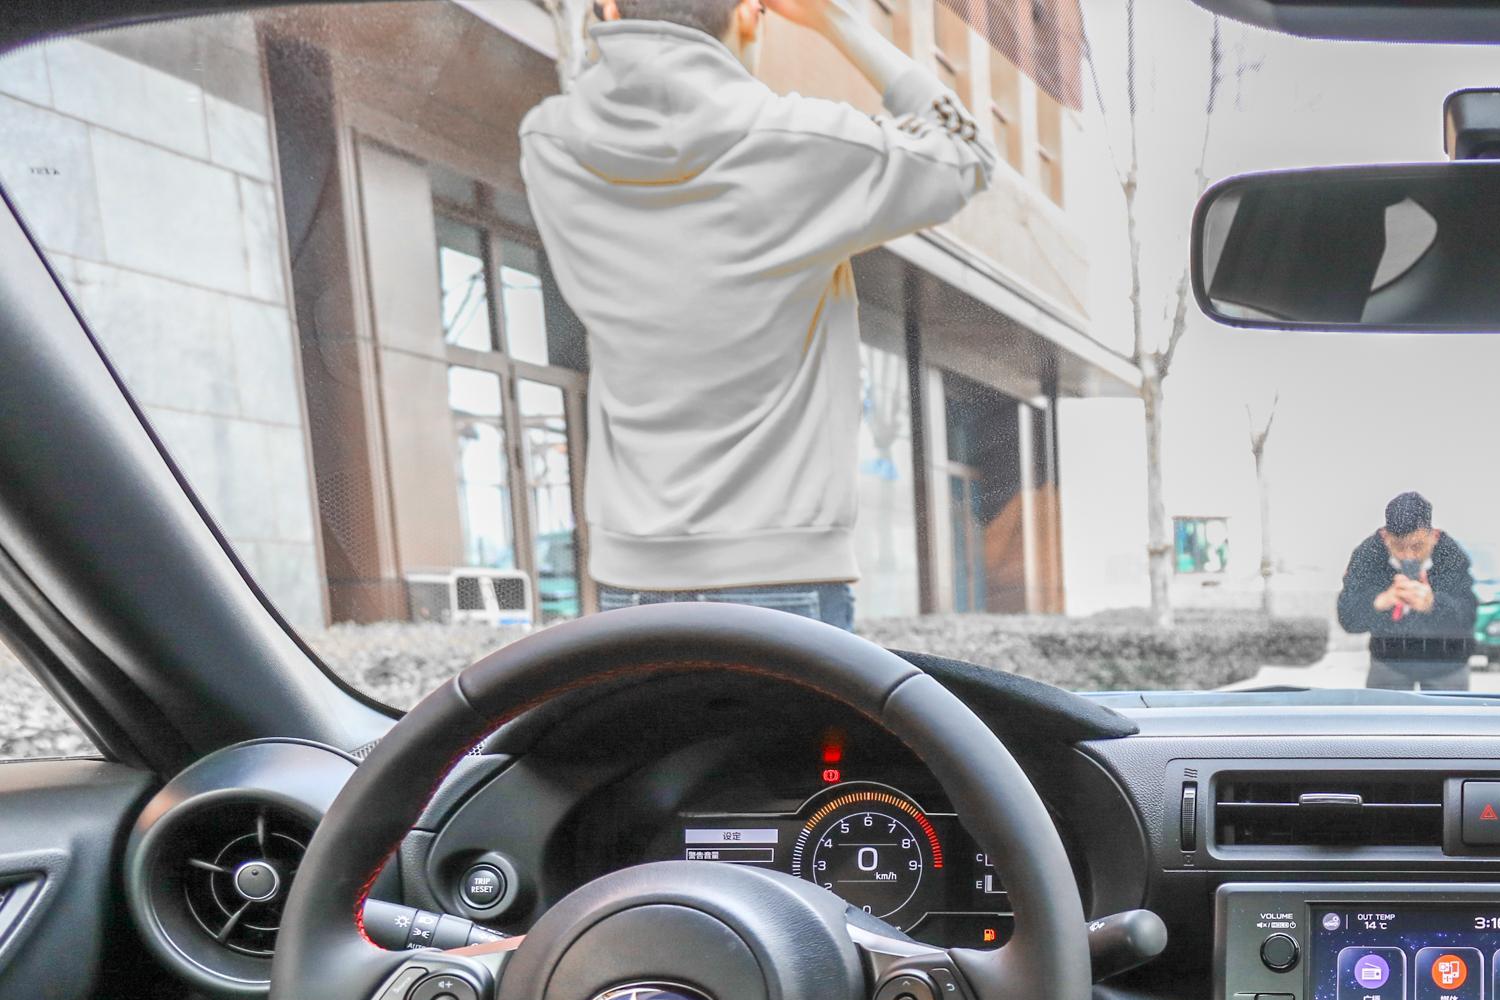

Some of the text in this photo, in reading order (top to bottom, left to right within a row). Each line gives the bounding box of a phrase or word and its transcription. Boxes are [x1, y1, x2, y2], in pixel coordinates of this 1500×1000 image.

[864, 817, 873, 826] 6
[841, 824, 849, 833] 5
[888, 824, 897, 833] 7
[723, 832, 741, 840] 设定
[824, 839, 833, 848] 4
[901, 838, 911, 849] 8
[857, 847, 878, 871] 0
[976, 853, 983, 862] C
[817, 861, 826, 870] 3
[908, 860, 918, 870] 9
[875, 872, 897, 880] km/h
[474, 878, 491, 886] TRIP
[976, 881, 983, 889] E
[471, 885, 494, 893] RESET
[1357, 913, 1396, 921] OUT TEMP
[1364, 921, 1377, 930] 14
